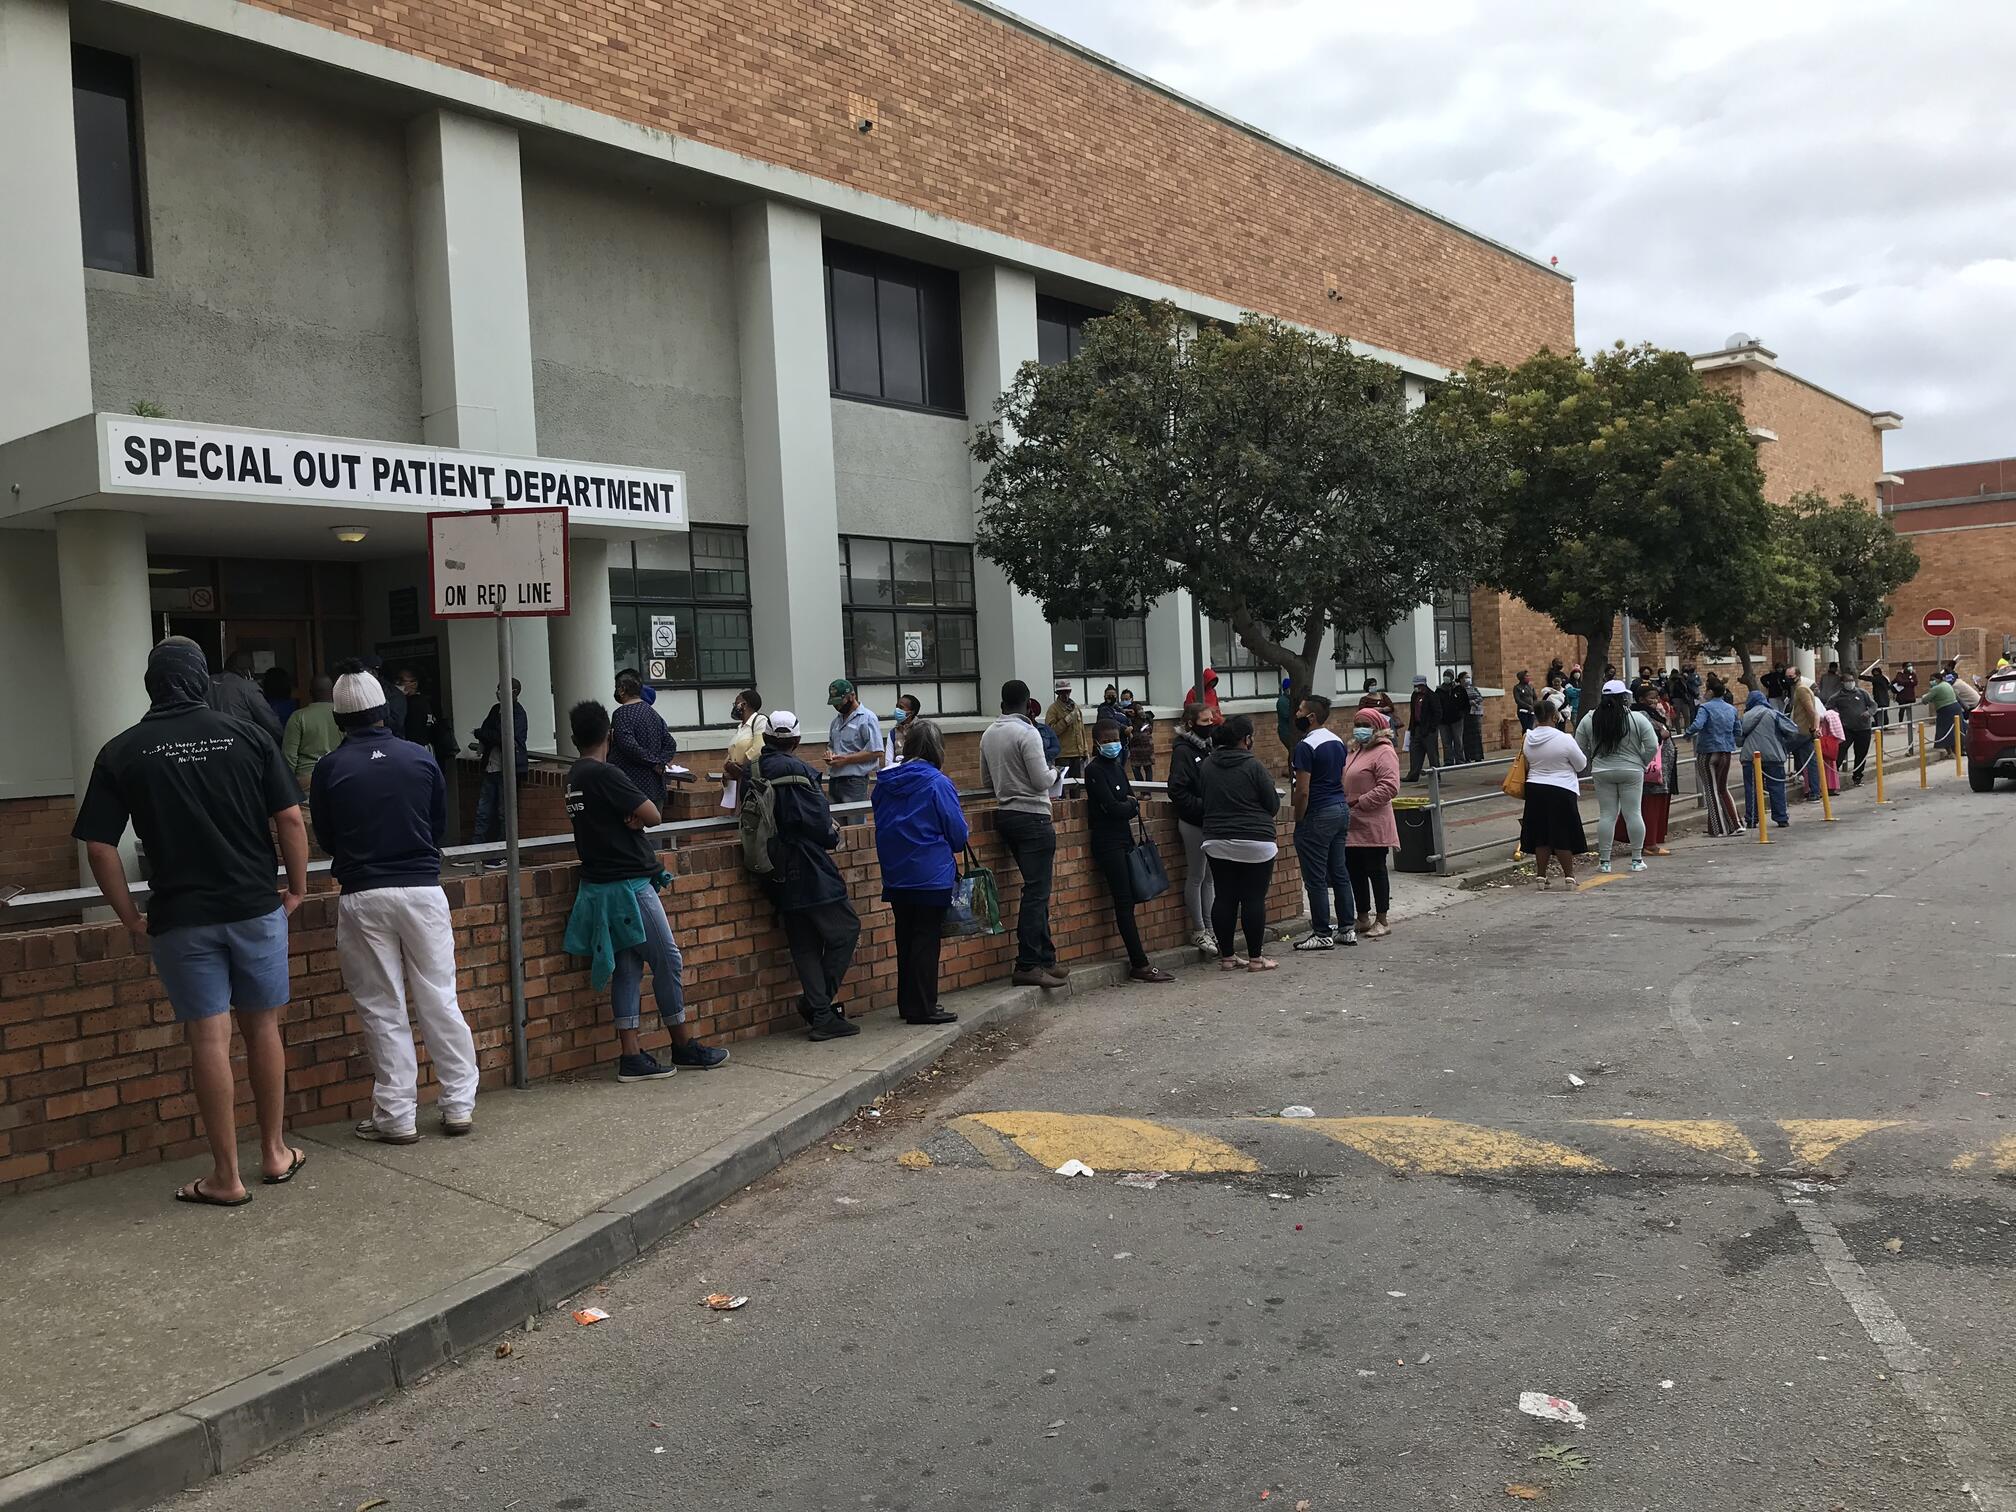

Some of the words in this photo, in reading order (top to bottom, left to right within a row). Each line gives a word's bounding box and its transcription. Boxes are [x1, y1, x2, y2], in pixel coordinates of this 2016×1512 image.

[123, 435, 283, 485] SPECIAL
[293, 449, 361, 490] OUT
[372, 457, 496, 499] PATIENT
[504, 469, 674, 514] DEPARTMENT
[445, 585, 467, 606] ON
[477, 583, 507, 605] RED
[518, 582, 552, 604] LINE
